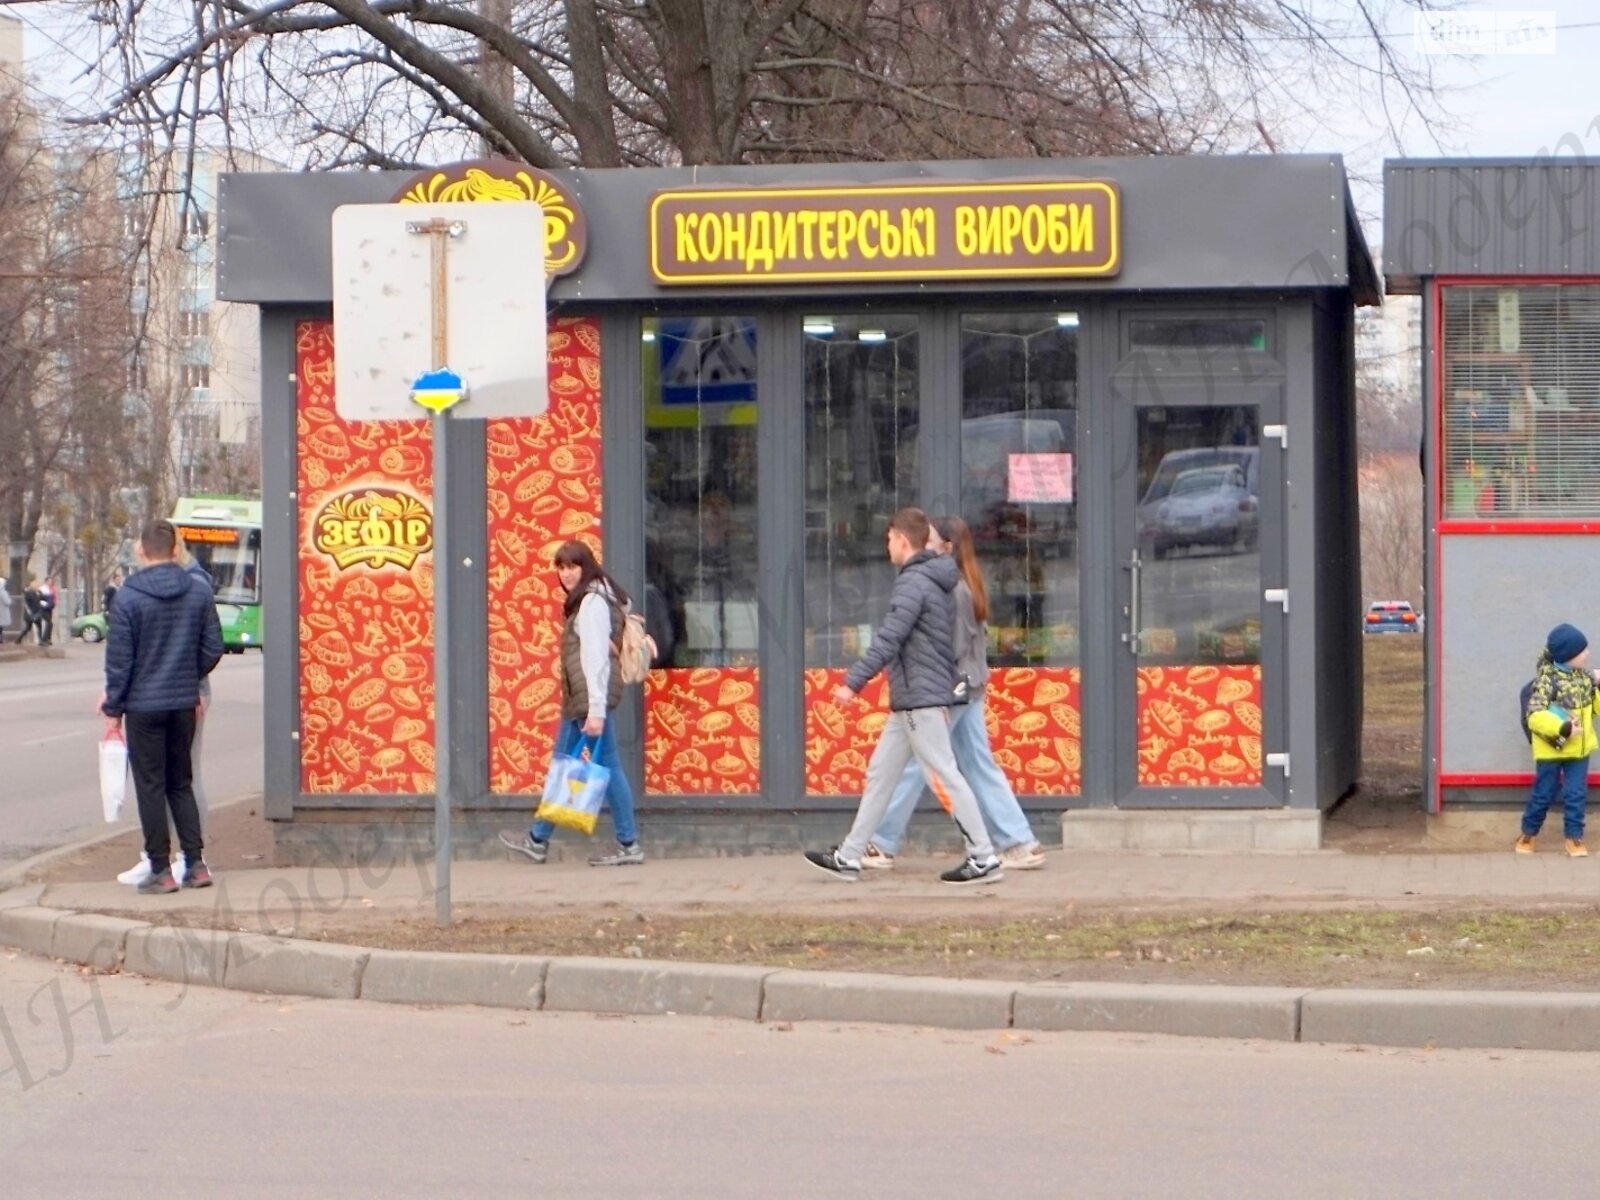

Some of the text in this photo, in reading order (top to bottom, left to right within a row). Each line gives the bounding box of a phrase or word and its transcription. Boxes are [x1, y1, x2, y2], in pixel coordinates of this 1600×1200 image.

[674, 203, 1094, 272] КОНДИТЕРСЬКІ ВИРОБИ
[322, 506, 427, 546] ЗЕФІР
